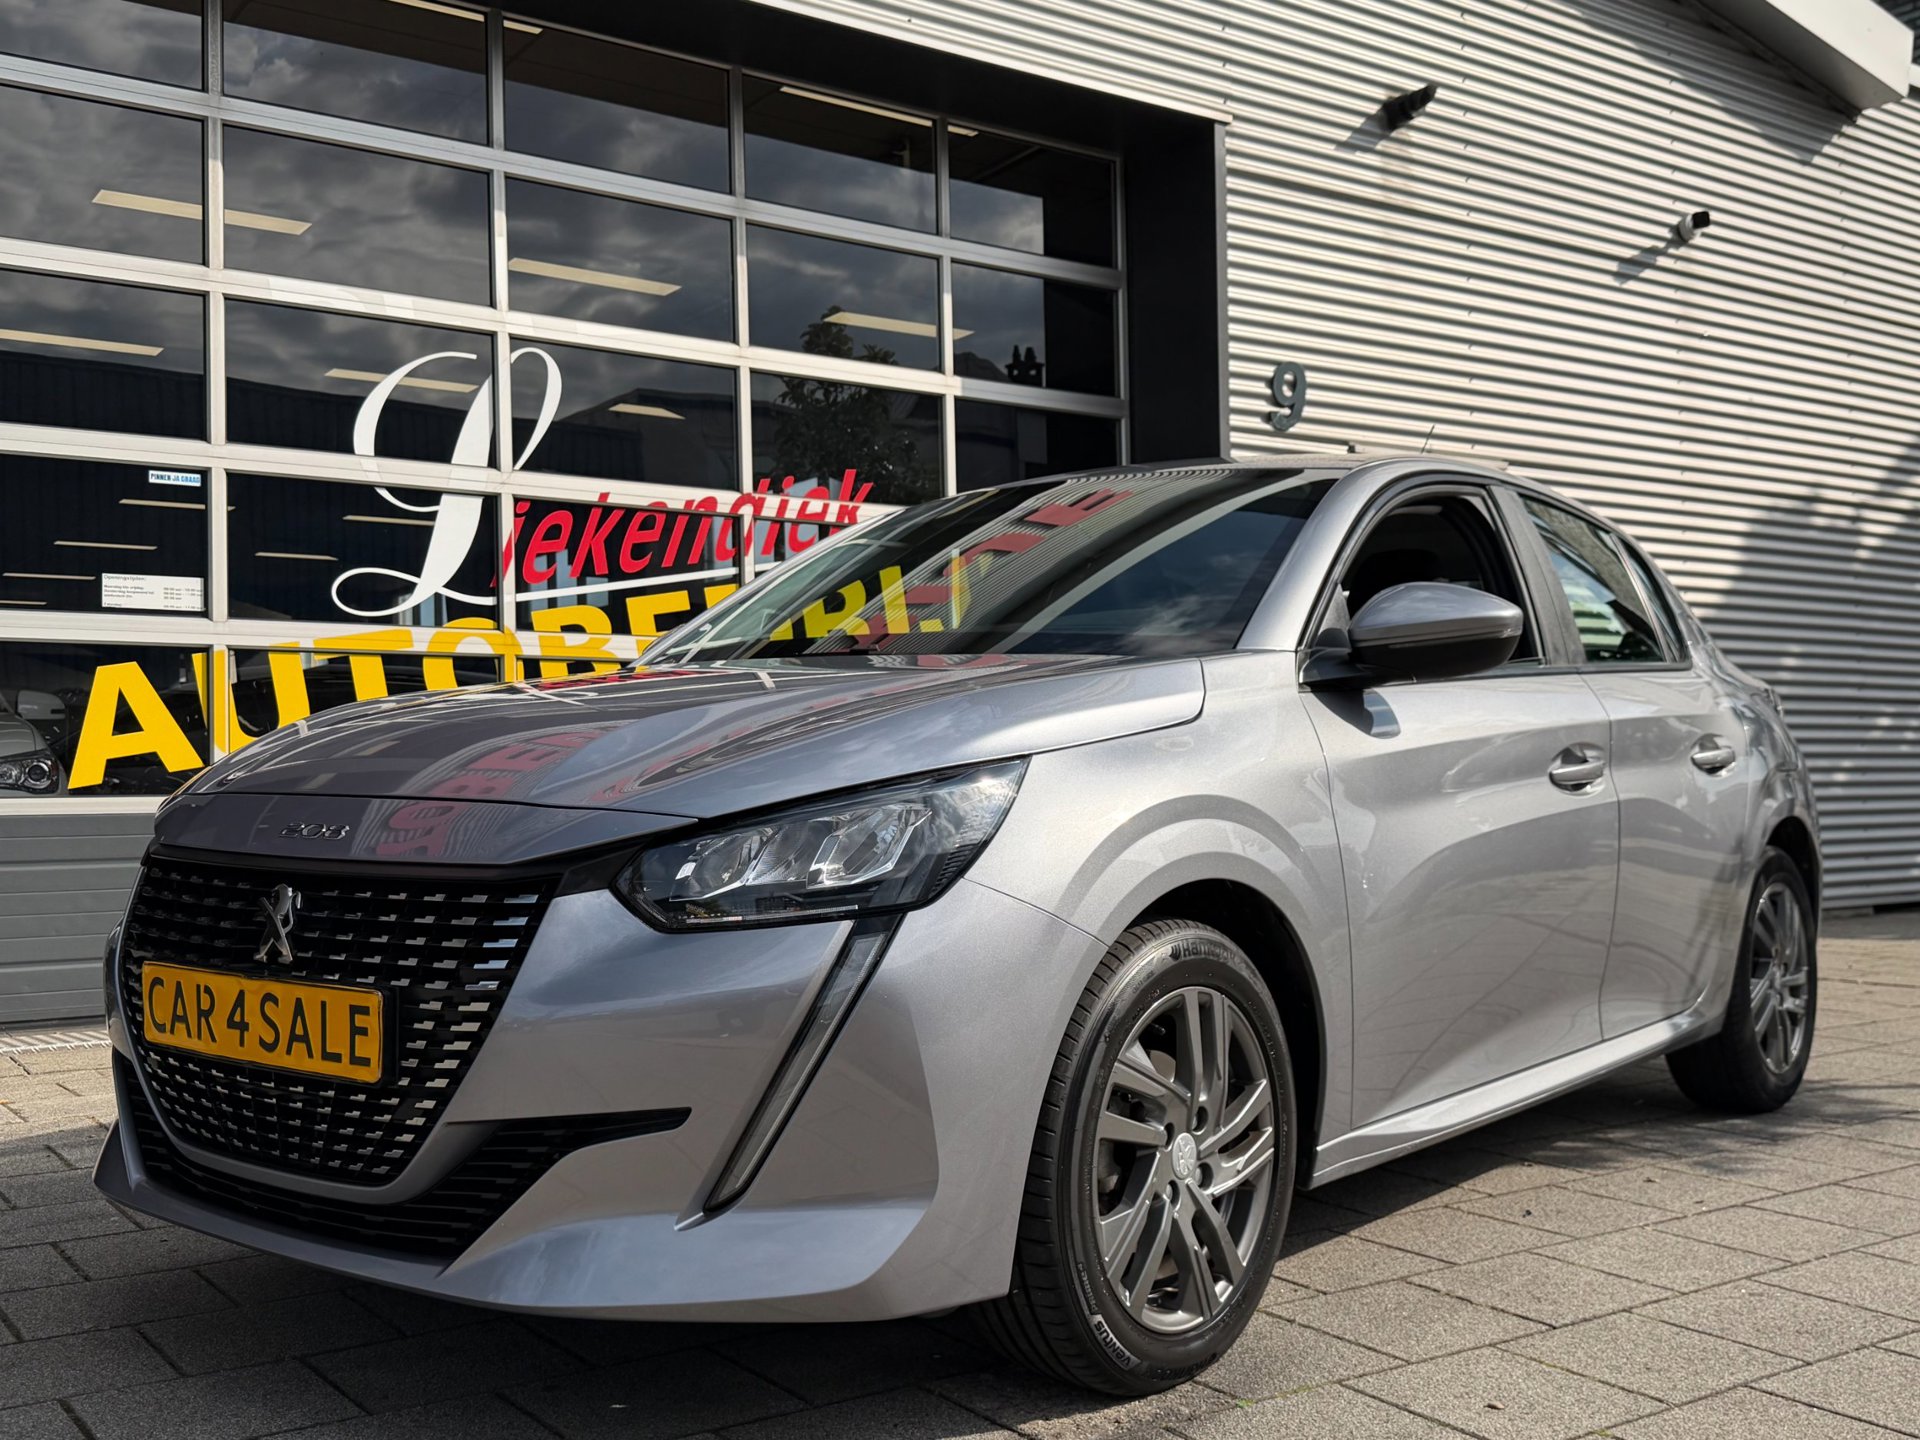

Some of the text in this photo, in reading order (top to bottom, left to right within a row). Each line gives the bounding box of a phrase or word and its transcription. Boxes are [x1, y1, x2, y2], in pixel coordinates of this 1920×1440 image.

[1270, 361, 1307, 432] 9
[280, 822, 350, 840] 208
[148, 976, 372, 1067] CAR 4 SALE
